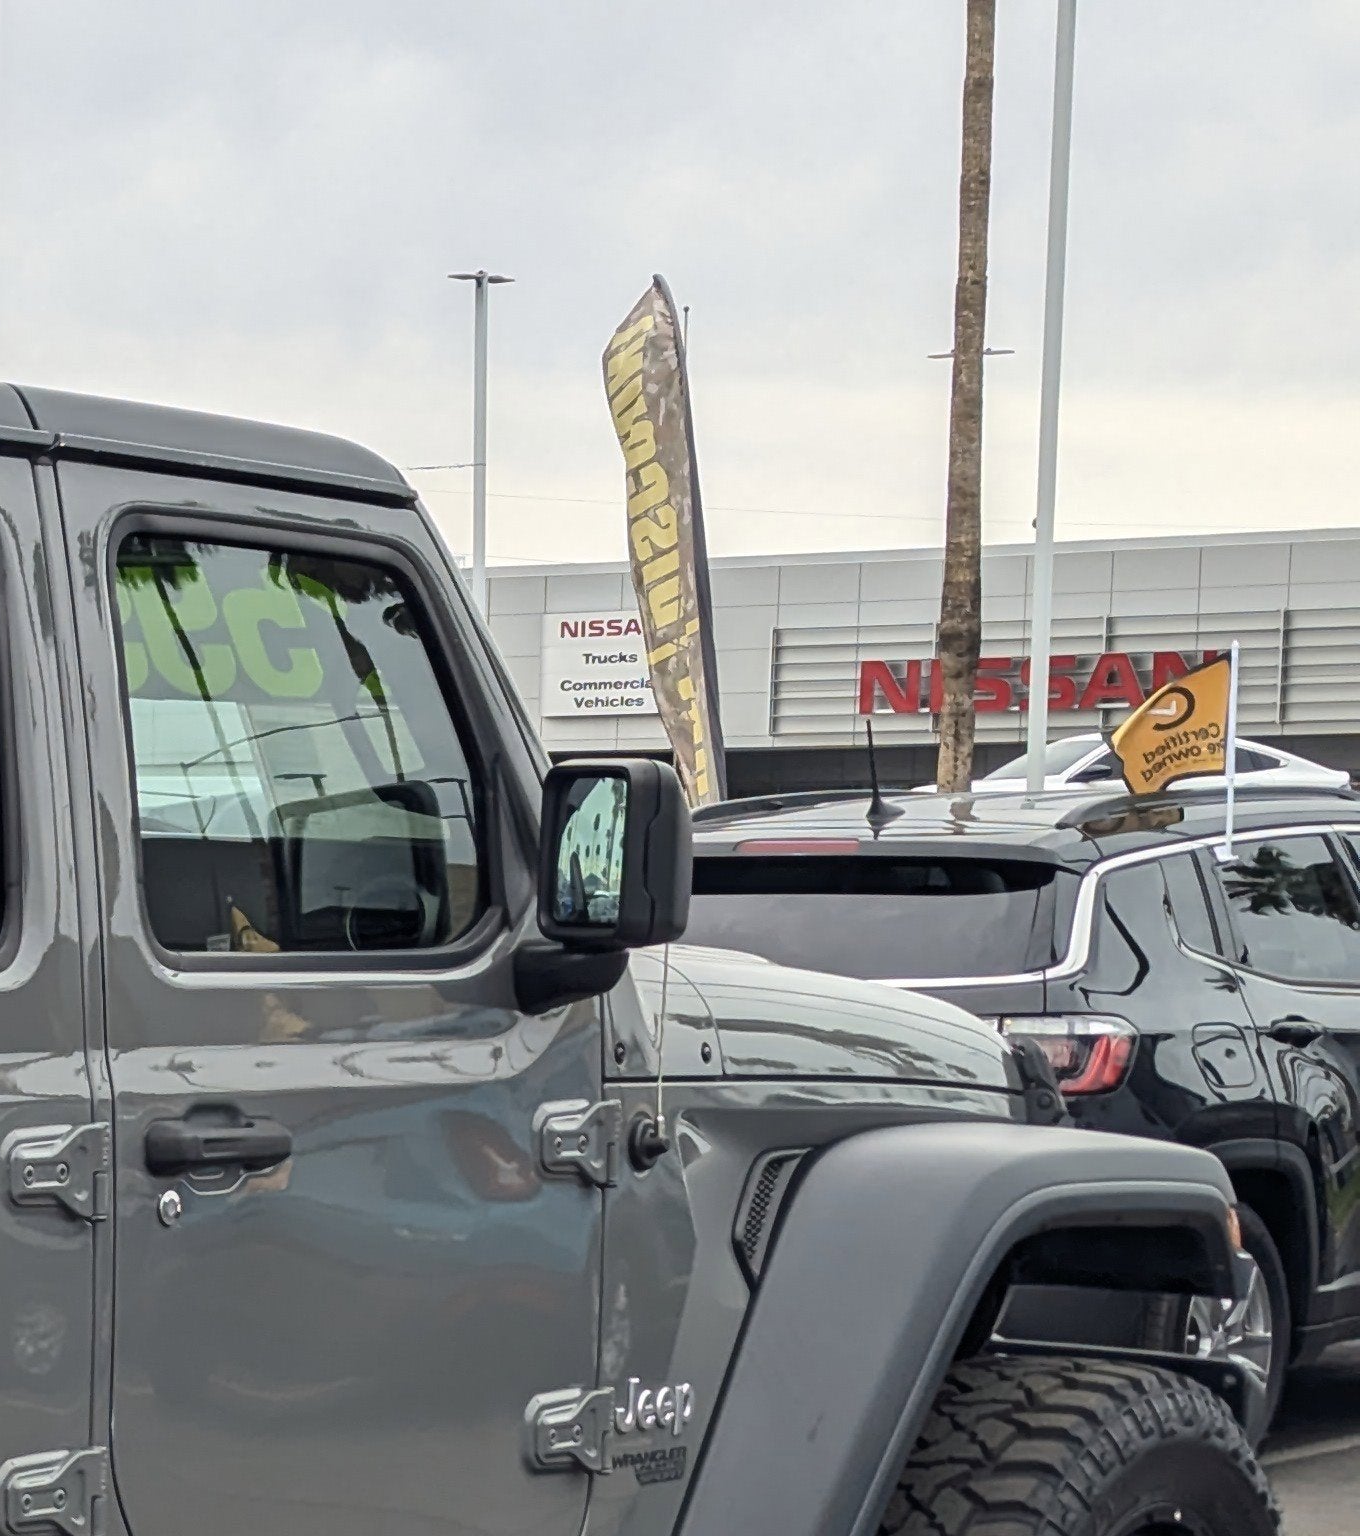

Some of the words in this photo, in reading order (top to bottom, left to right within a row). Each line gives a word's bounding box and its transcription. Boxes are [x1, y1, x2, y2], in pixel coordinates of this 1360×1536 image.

[560, 619, 642, 638] NISSA
[582, 652, 638, 665] Trucks
[560, 677, 653, 692] Commercia
[574, 696, 645, 709] Vehicles
[614, 1377, 695, 1436] Jeep
